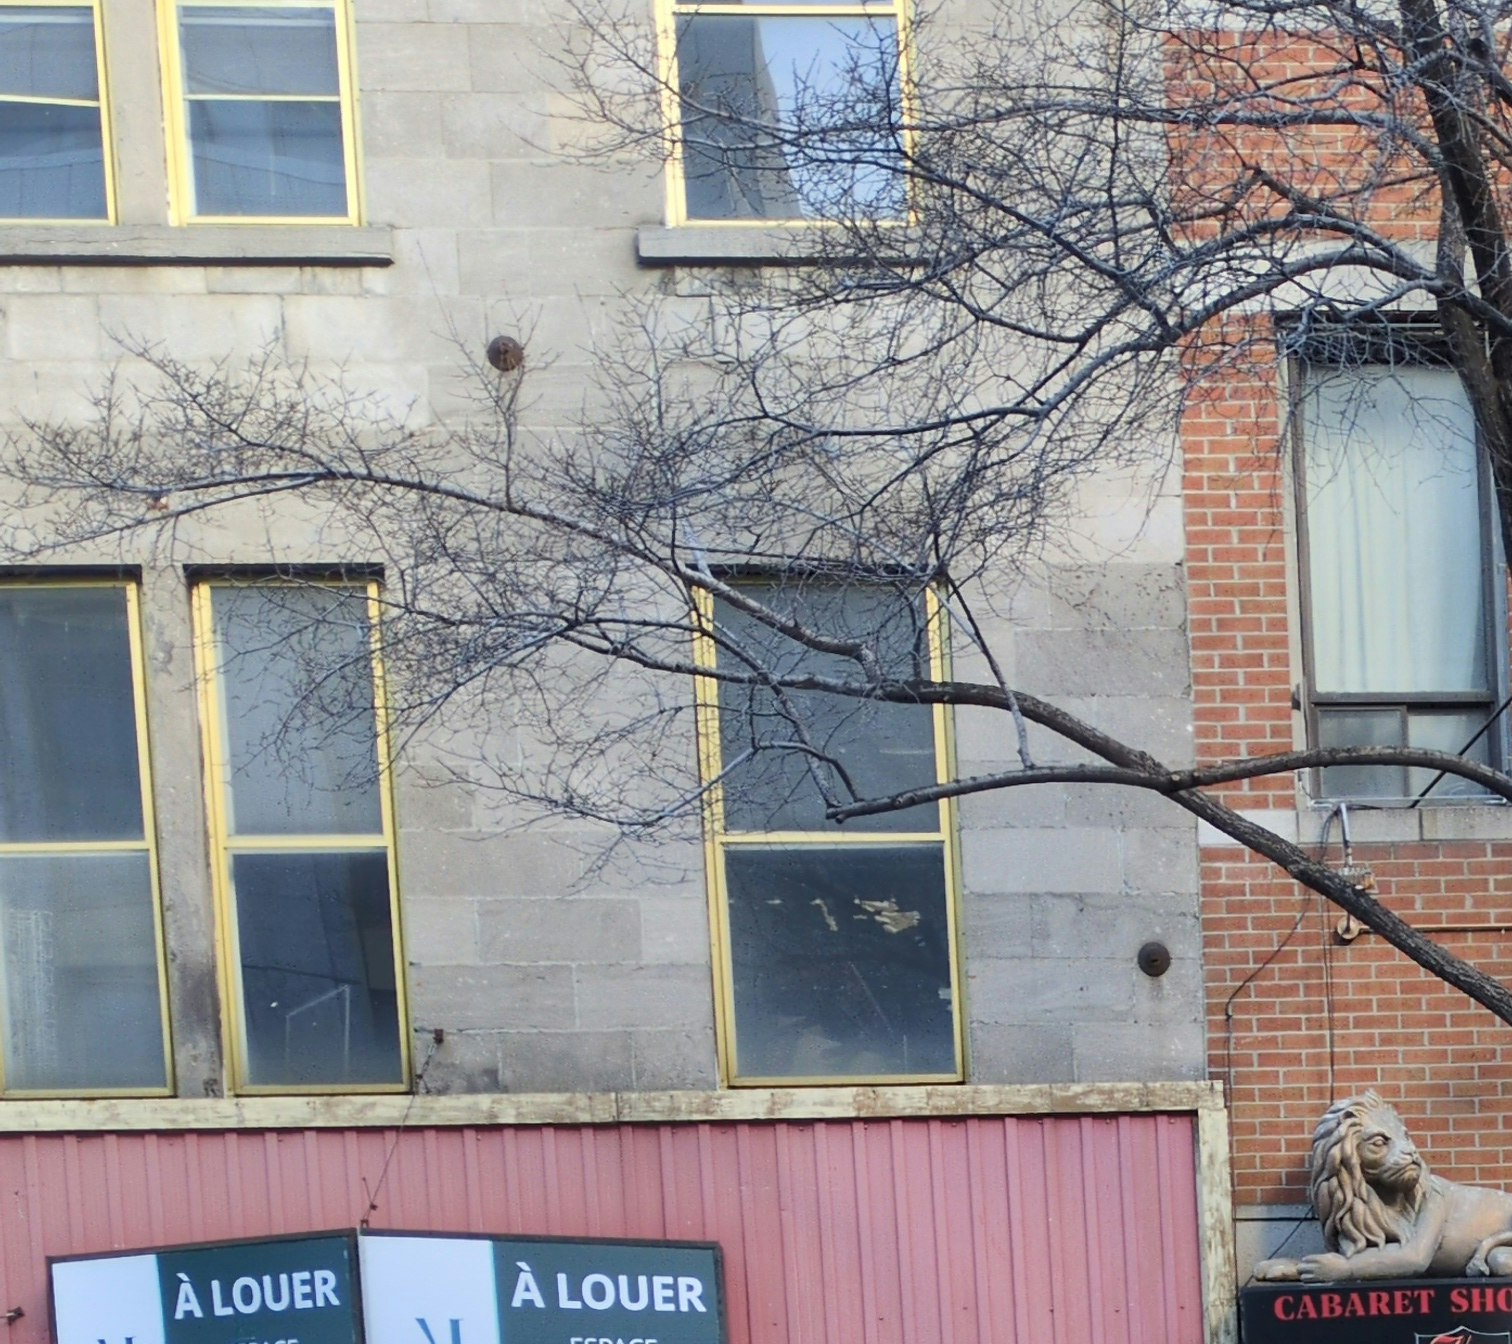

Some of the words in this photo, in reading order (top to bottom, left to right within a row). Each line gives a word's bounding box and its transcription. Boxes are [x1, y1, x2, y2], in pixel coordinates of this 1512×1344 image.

[174, 1272, 203, 1320] À
[213, 1270, 340, 1316] LOUER
[512, 1262, 545, 1309] À
[557, 1274, 706, 1312] LOUER
[1273, 1289, 1436, 1321] CABARET
